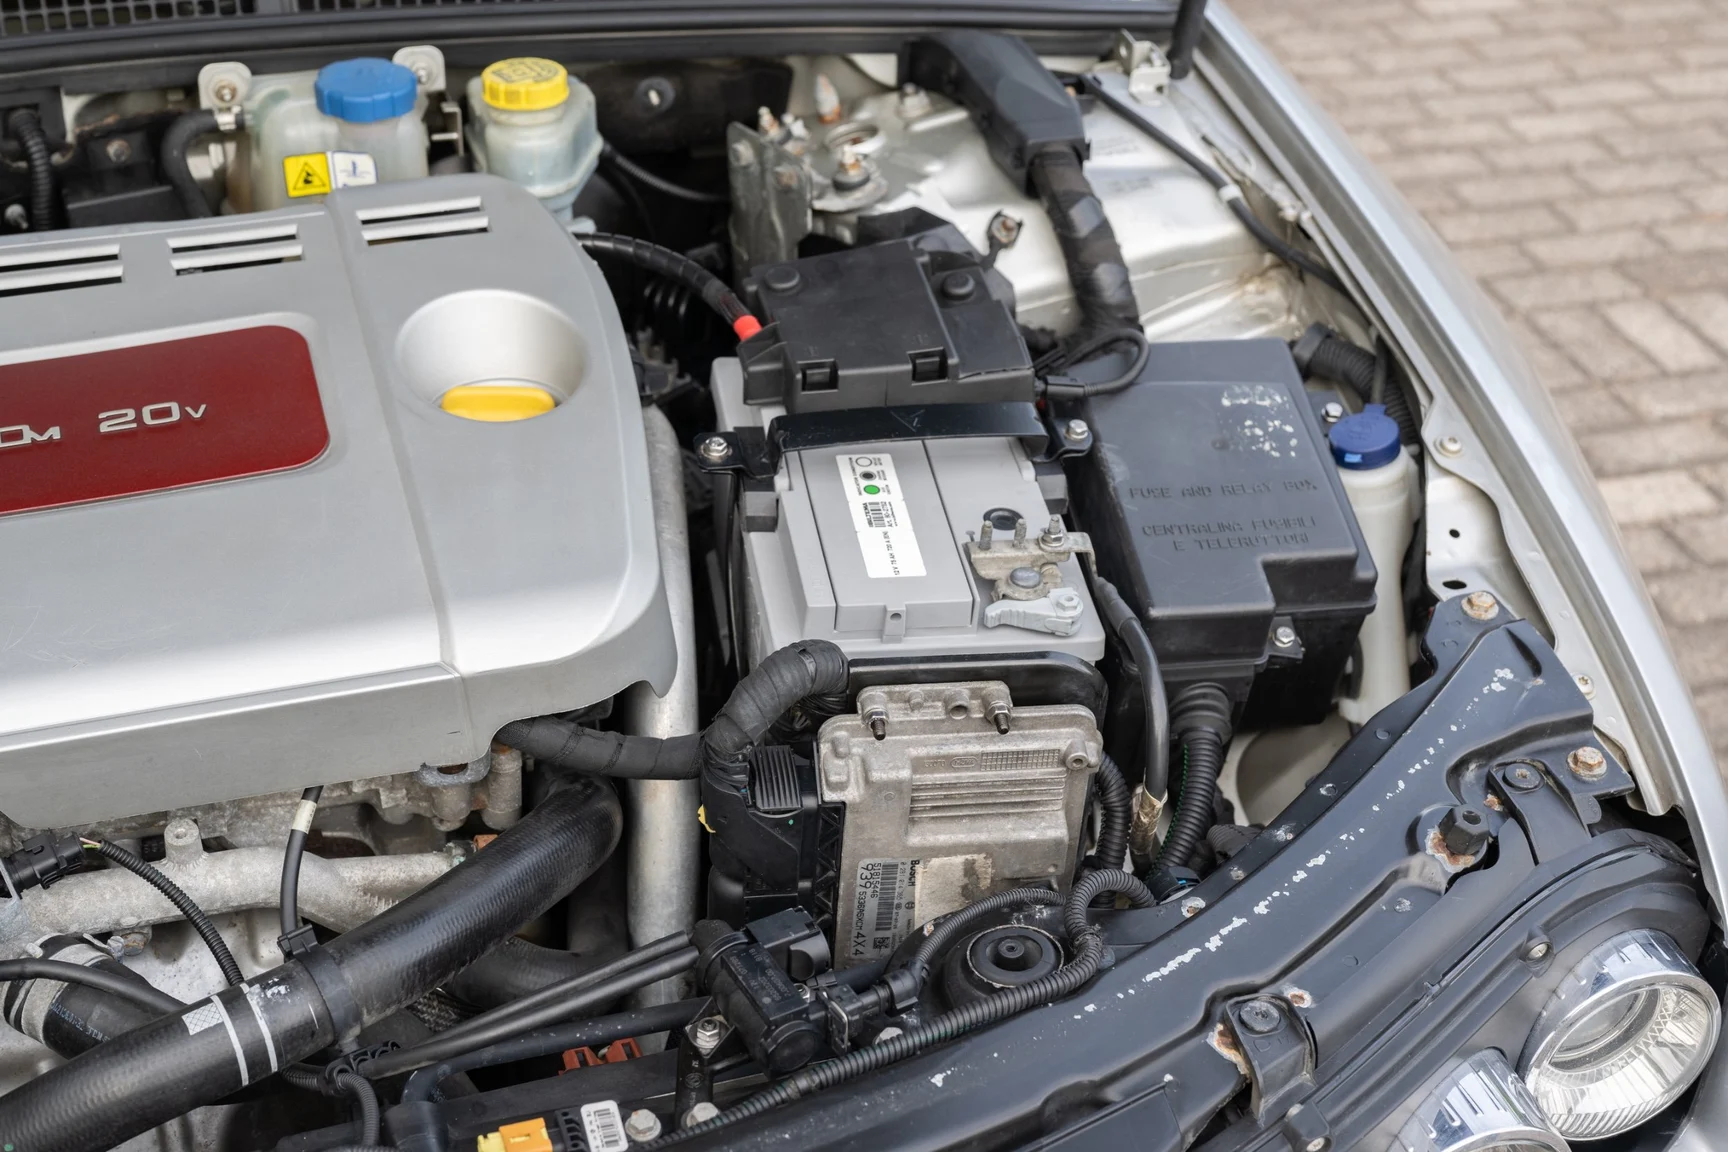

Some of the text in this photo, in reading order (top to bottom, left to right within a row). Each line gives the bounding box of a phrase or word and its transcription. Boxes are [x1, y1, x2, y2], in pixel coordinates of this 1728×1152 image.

[1128, 486, 1173, 500] FUSE
[1181, 485, 1212, 498] AND
[1220, 482, 1273, 497] RELAY
[1142, 515, 1317, 538] CENTRALINA FUSIBILI
[1173, 532, 1310, 552] E TELERUTTORI
[859, 863, 874, 889] 939
[870, 862, 882, 899] 51815446
[908, 859, 921, 887] BOSCH
[851, 931, 867, 956] 4X4
